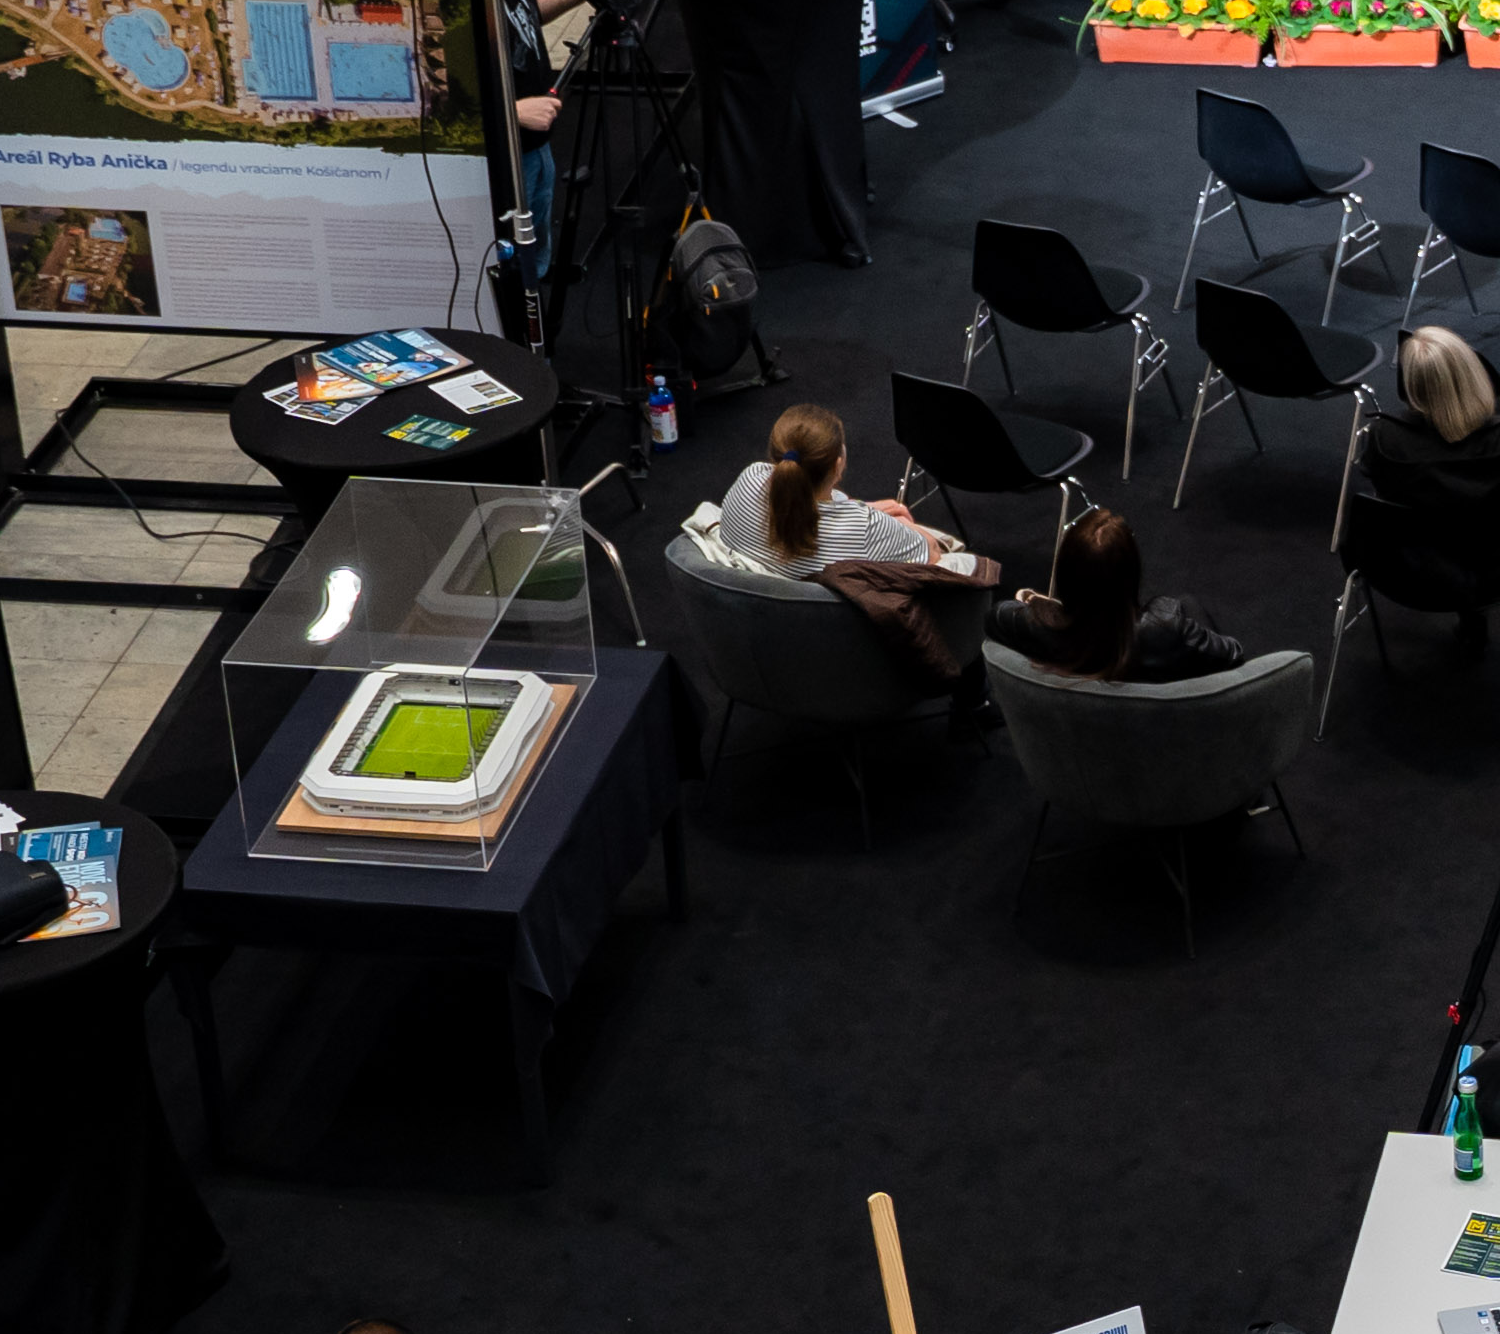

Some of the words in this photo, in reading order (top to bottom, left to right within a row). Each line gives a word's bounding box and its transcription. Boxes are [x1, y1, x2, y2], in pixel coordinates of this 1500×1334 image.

[48, 151, 96, 169] Ryba
[101, 152, 168, 171] Anička
[180, 159, 237, 176] legendu
